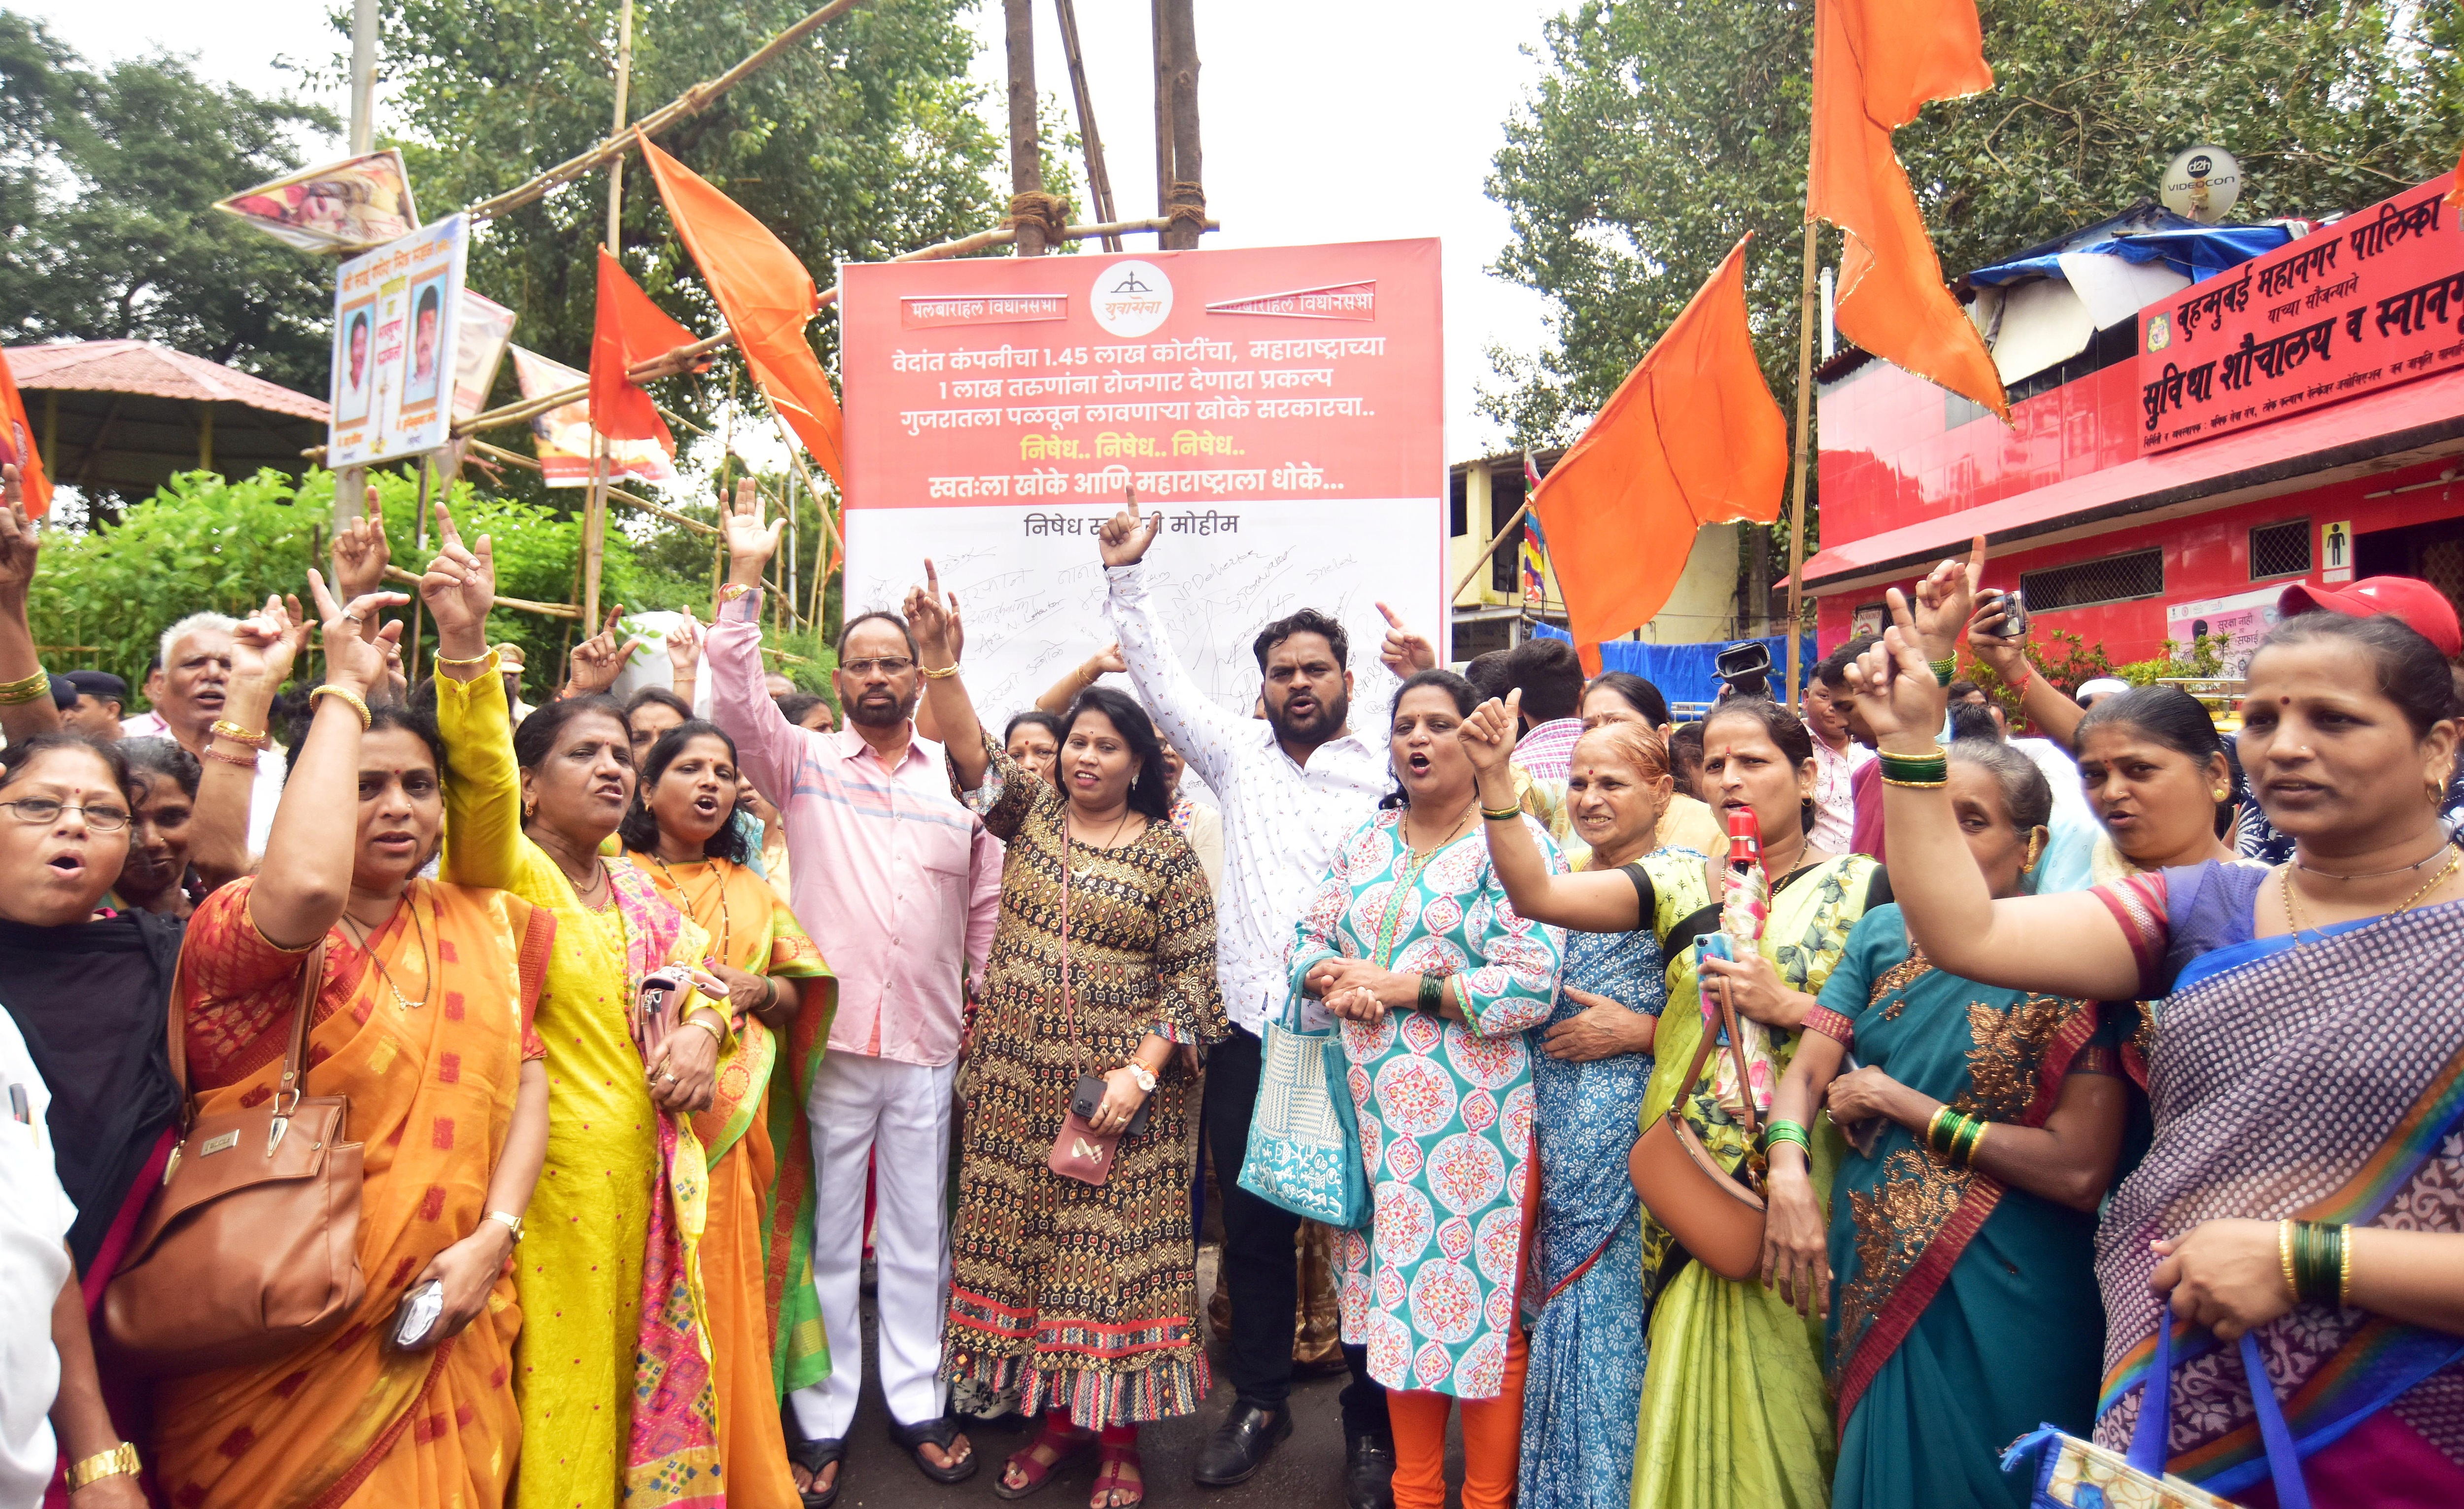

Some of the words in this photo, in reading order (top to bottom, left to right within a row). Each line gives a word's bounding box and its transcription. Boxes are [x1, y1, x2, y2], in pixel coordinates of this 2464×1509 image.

[2188, 160, 2211, 172] d2h
[2168, 176, 2235, 191] VIDEOCON
[2258, 237, 2342, 297] महानगर
[2350, 192, 2445, 261] पालिका
[1105, 295, 1162, 321] युवासेना
[2268, 299, 2301, 323] याच्या
[2306, 272, 2359, 309] सौजन्याने
[891, 349, 945, 372] वेदांत
[949, 344, 1039, 370] कंपनीचा
[1043, 347, 1088, 367] 1.45
[1094, 344, 1146, 364] लाख
[1151, 337, 1237, 363] कोटींचा,
[1249, 337, 1386, 361] महाराष्ट्राच्या
[2143, 360, 2217, 431] सुविधा
[2219, 316, 2336, 391] शौचालय
[2346, 305, 2367, 343] व
[939, 381, 947, 400] 1
[952, 379, 1003, 399] लाख
[1008, 372, 1099, 396] तरुणांना
[1103, 370, 1184, 393] रोजगार
[1189, 367, 1255, 391] देणारा
[1259, 368, 1334, 389] प्रकल्प
[900, 408, 1003, 436] गुजरातला
[1006, 406, 1081, 431] पळवून
[1195, 395, 1251, 420] खोके
[1256, 398, 1375, 418] सरकारचा..
[1020, 433, 1091, 461] निषेध..
[1095, 431, 1166, 459] निषेध..
[1171, 429, 1245, 456] निषेध..
[1013, 467, 1069, 496] खोके
[1074, 464, 1132, 494] आणि
[1135, 468, 1267, 495] महाराष्ट्राला
[1272, 461, 1344, 491] धोके...
[1024, 513, 1083, 537] निषेध
[1169, 510, 1240, 536] मोहीम
[2218, 618, 2237, 633] सुरक्षा
[2238, 612, 2253, 625] नाही
[2236, 630, 2259, 645] सफाई
